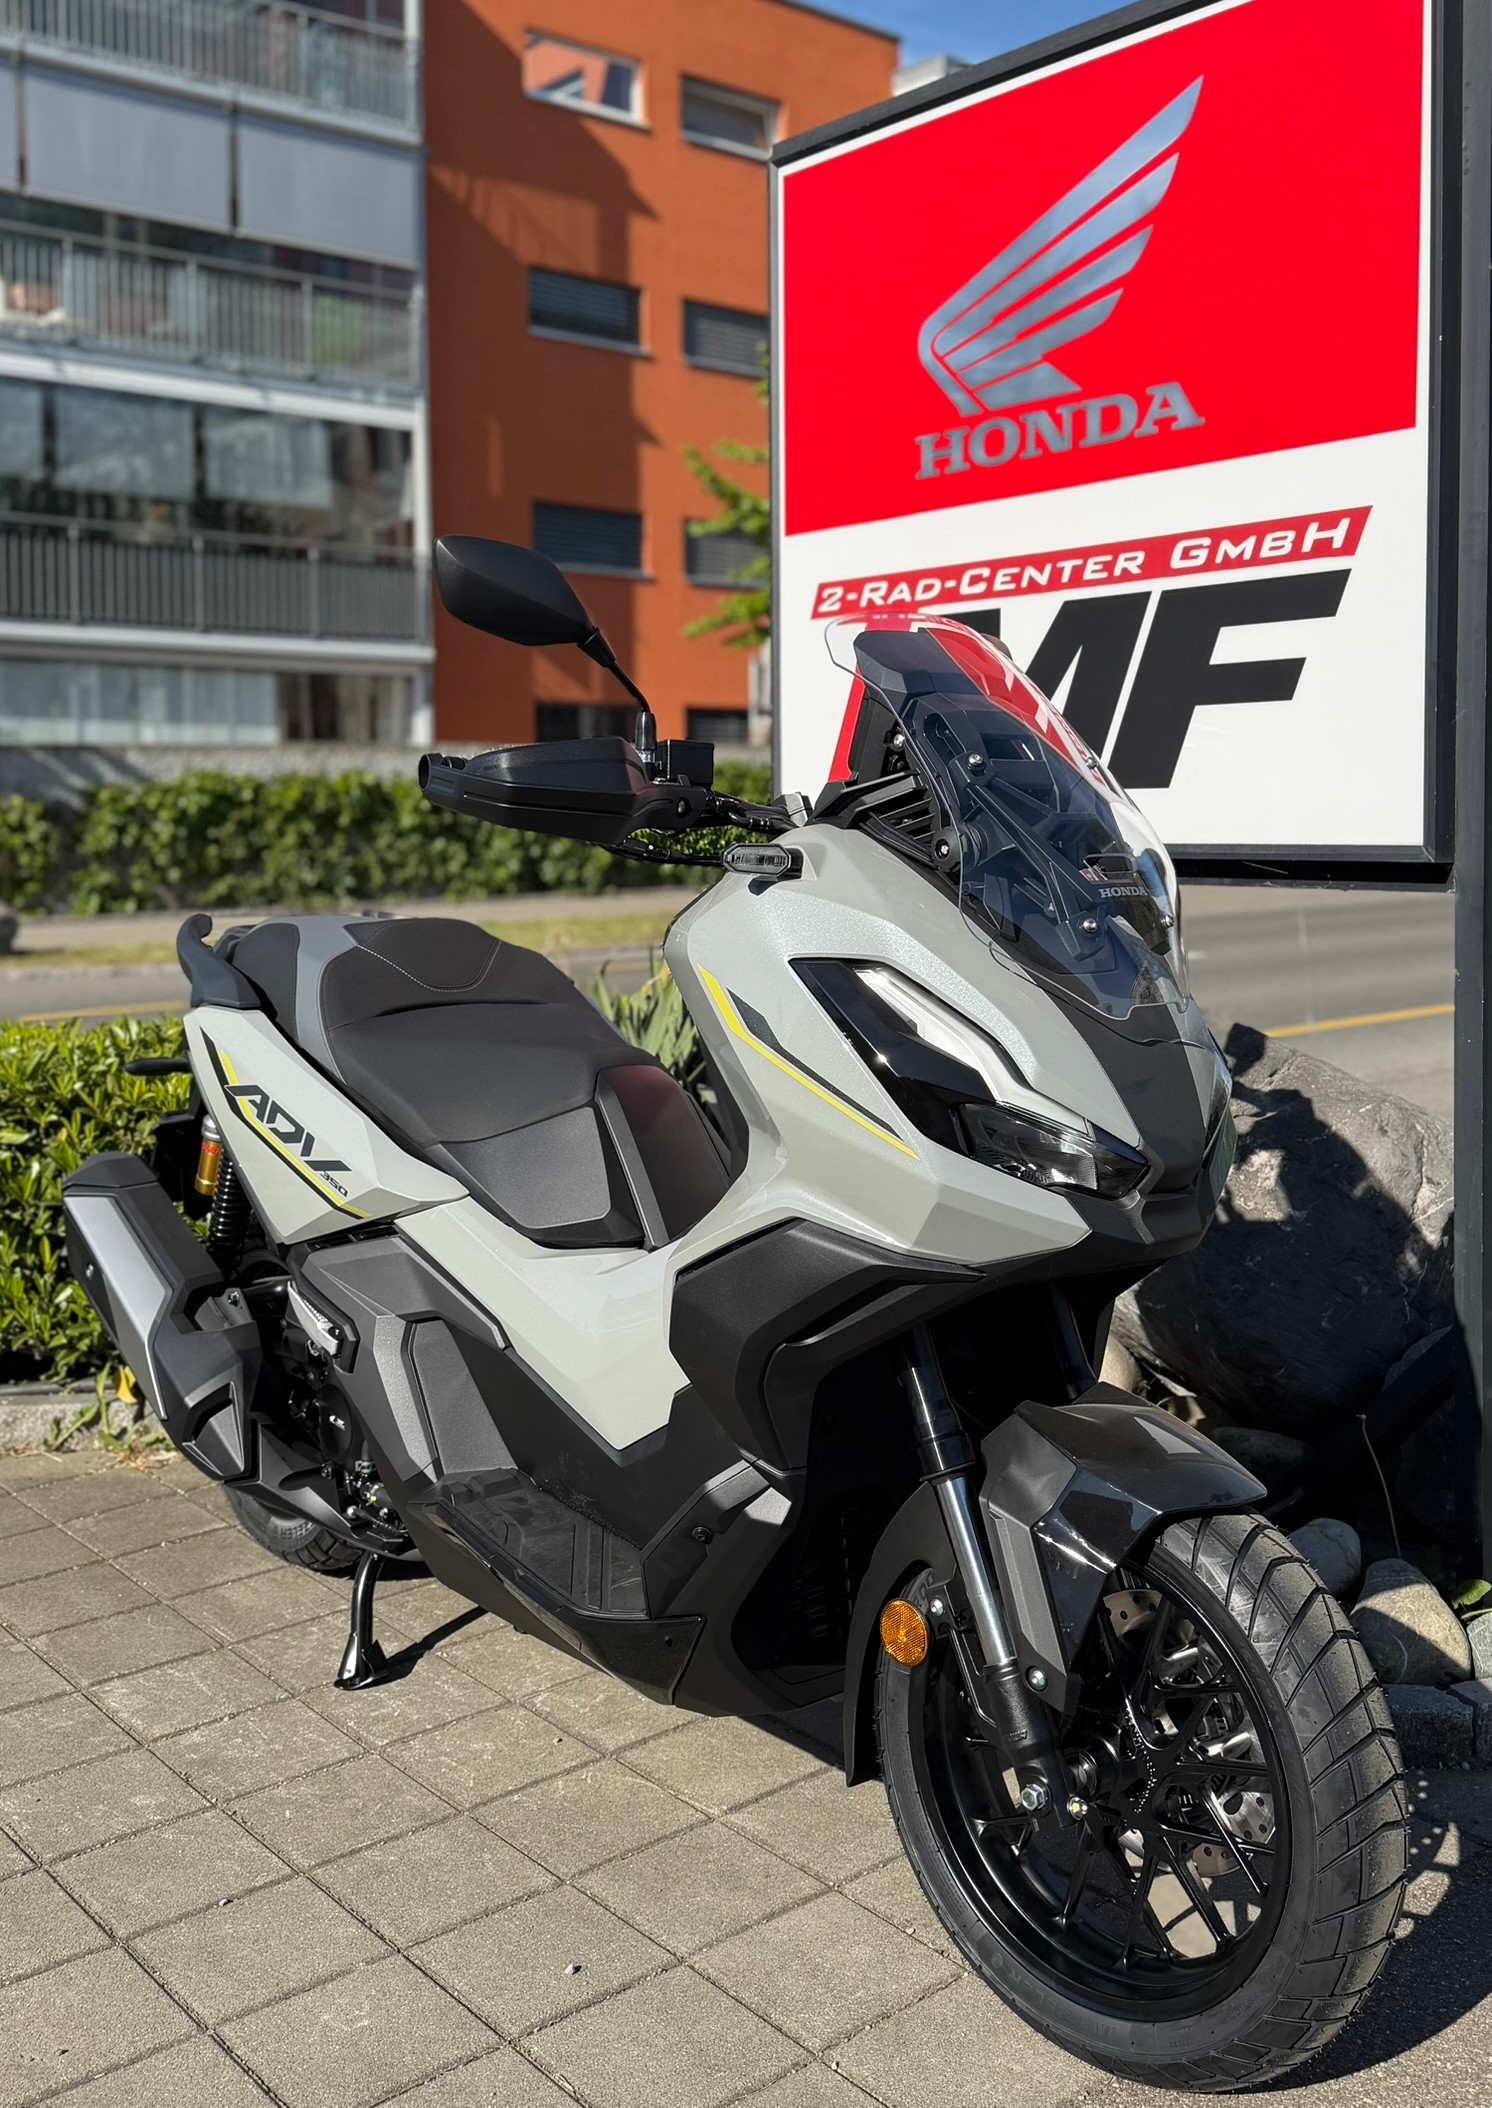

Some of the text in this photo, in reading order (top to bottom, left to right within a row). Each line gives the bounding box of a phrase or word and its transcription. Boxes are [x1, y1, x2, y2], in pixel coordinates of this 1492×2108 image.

[914, 381, 1206, 480] HONDA
[1098, 886, 1148, 898] HONDA
[224, 1084, 352, 1198] ADV 350
